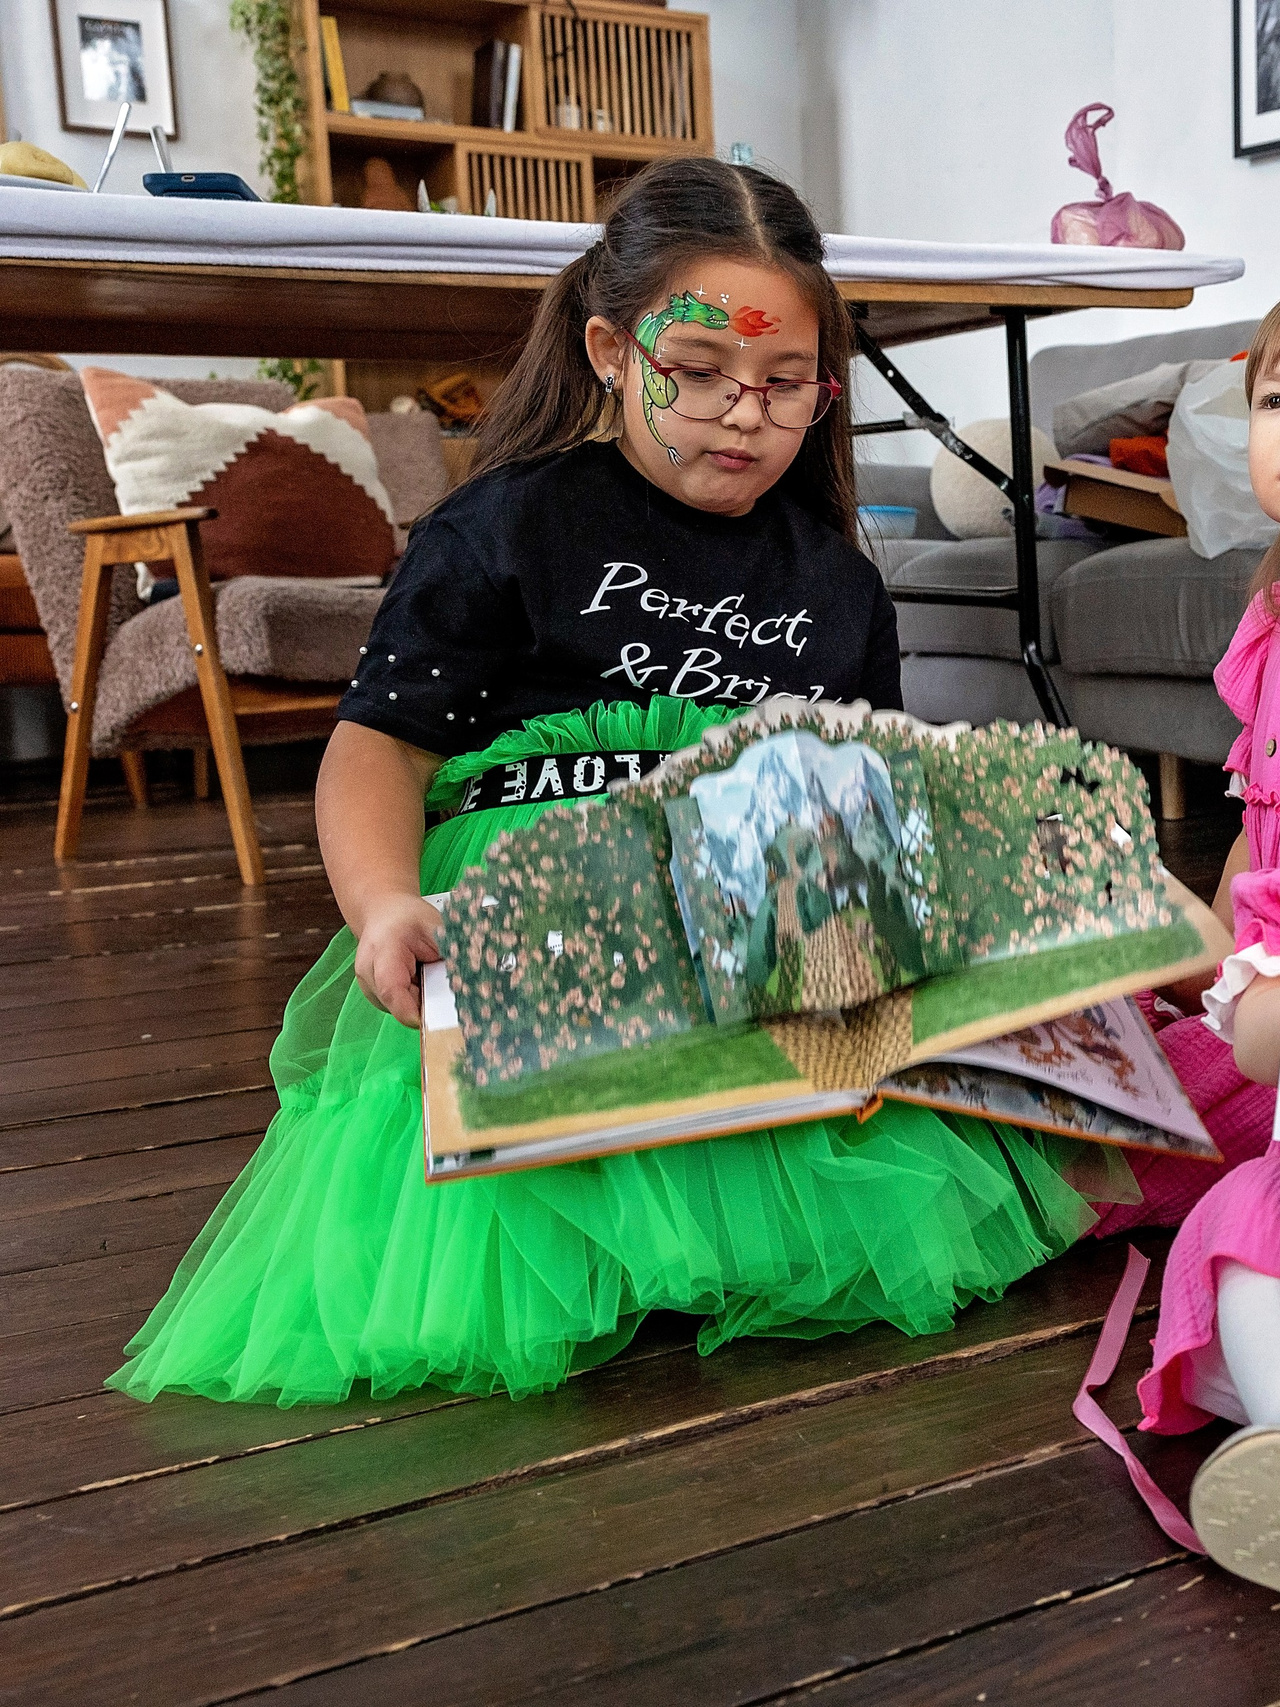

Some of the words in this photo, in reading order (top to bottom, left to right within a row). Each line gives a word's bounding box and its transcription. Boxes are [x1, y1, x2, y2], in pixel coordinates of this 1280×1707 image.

[580, 561, 813, 657] Perfect
[600, 642, 668, 692] &
[669, 647, 843, 705] Bri
[500, 752, 641, 803] LOVE
